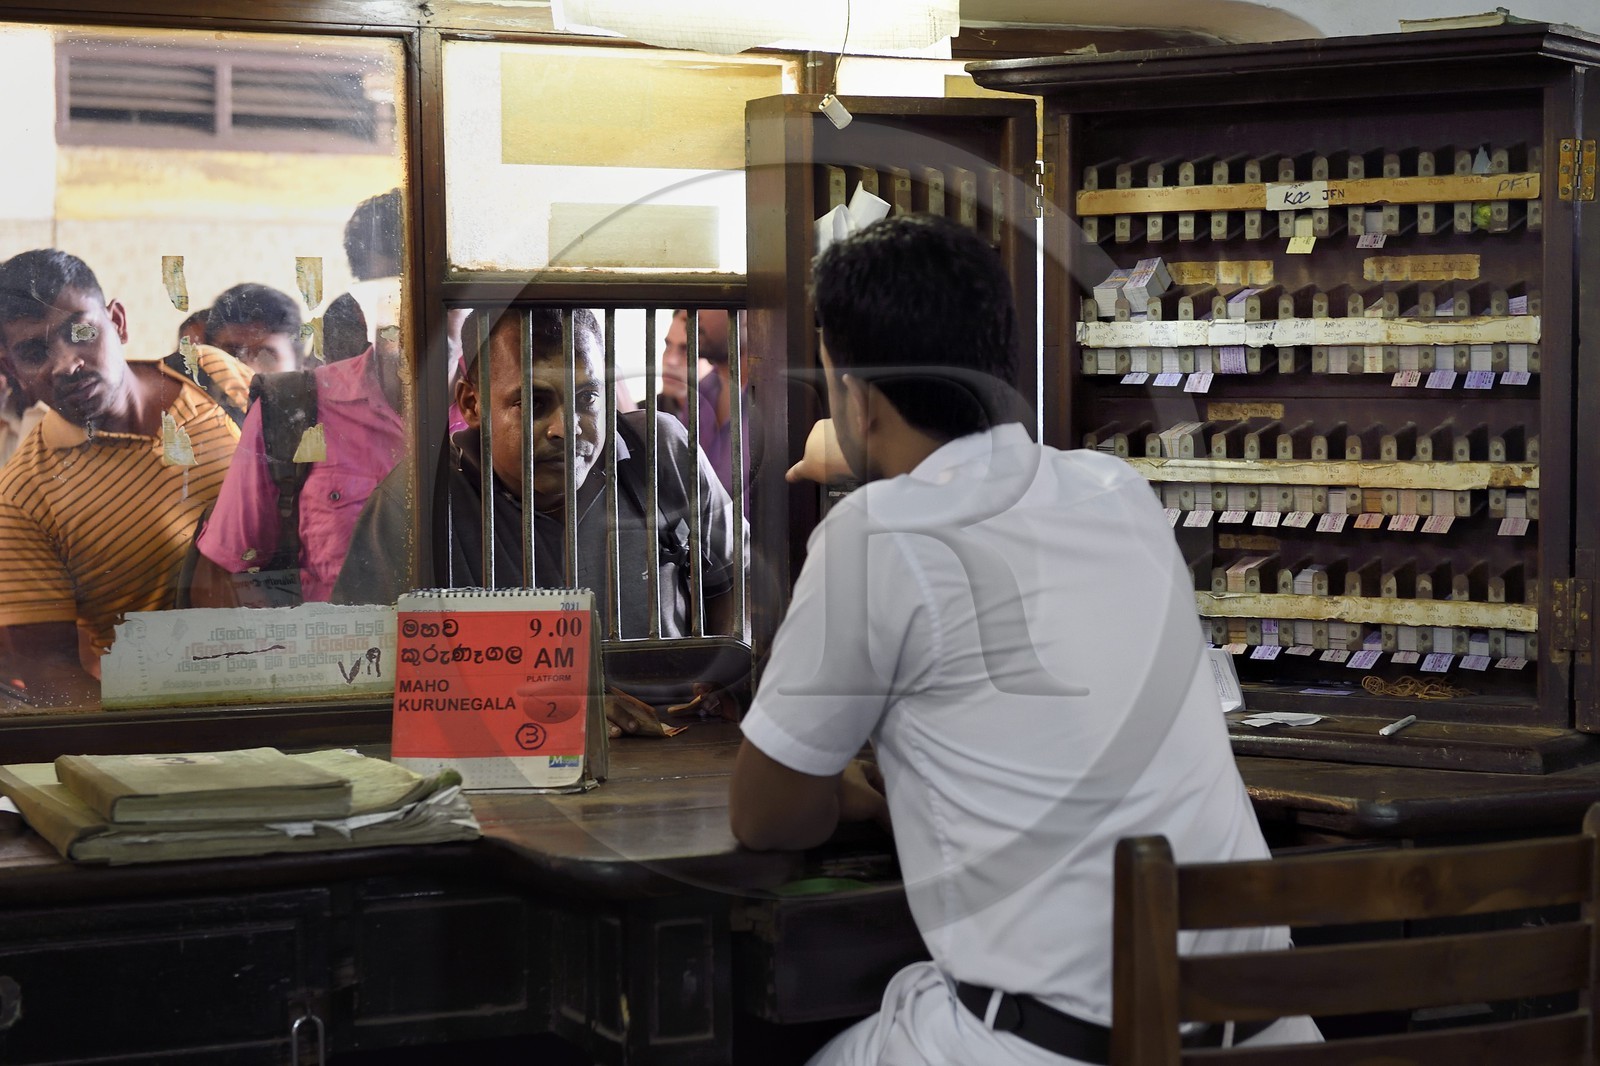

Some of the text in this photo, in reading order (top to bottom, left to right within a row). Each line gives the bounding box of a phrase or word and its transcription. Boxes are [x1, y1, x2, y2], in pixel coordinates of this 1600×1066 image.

[1322, 188, 1345, 201] JFN
[402, 619, 459, 638] මහව
[534, 647, 574, 668] AM
[400, 679, 450, 693] MAHO
[526, 674, 572, 683] PLATFORM
[398, 697, 516, 712] KURUNEGALA
[546, 702, 557, 718] 2
